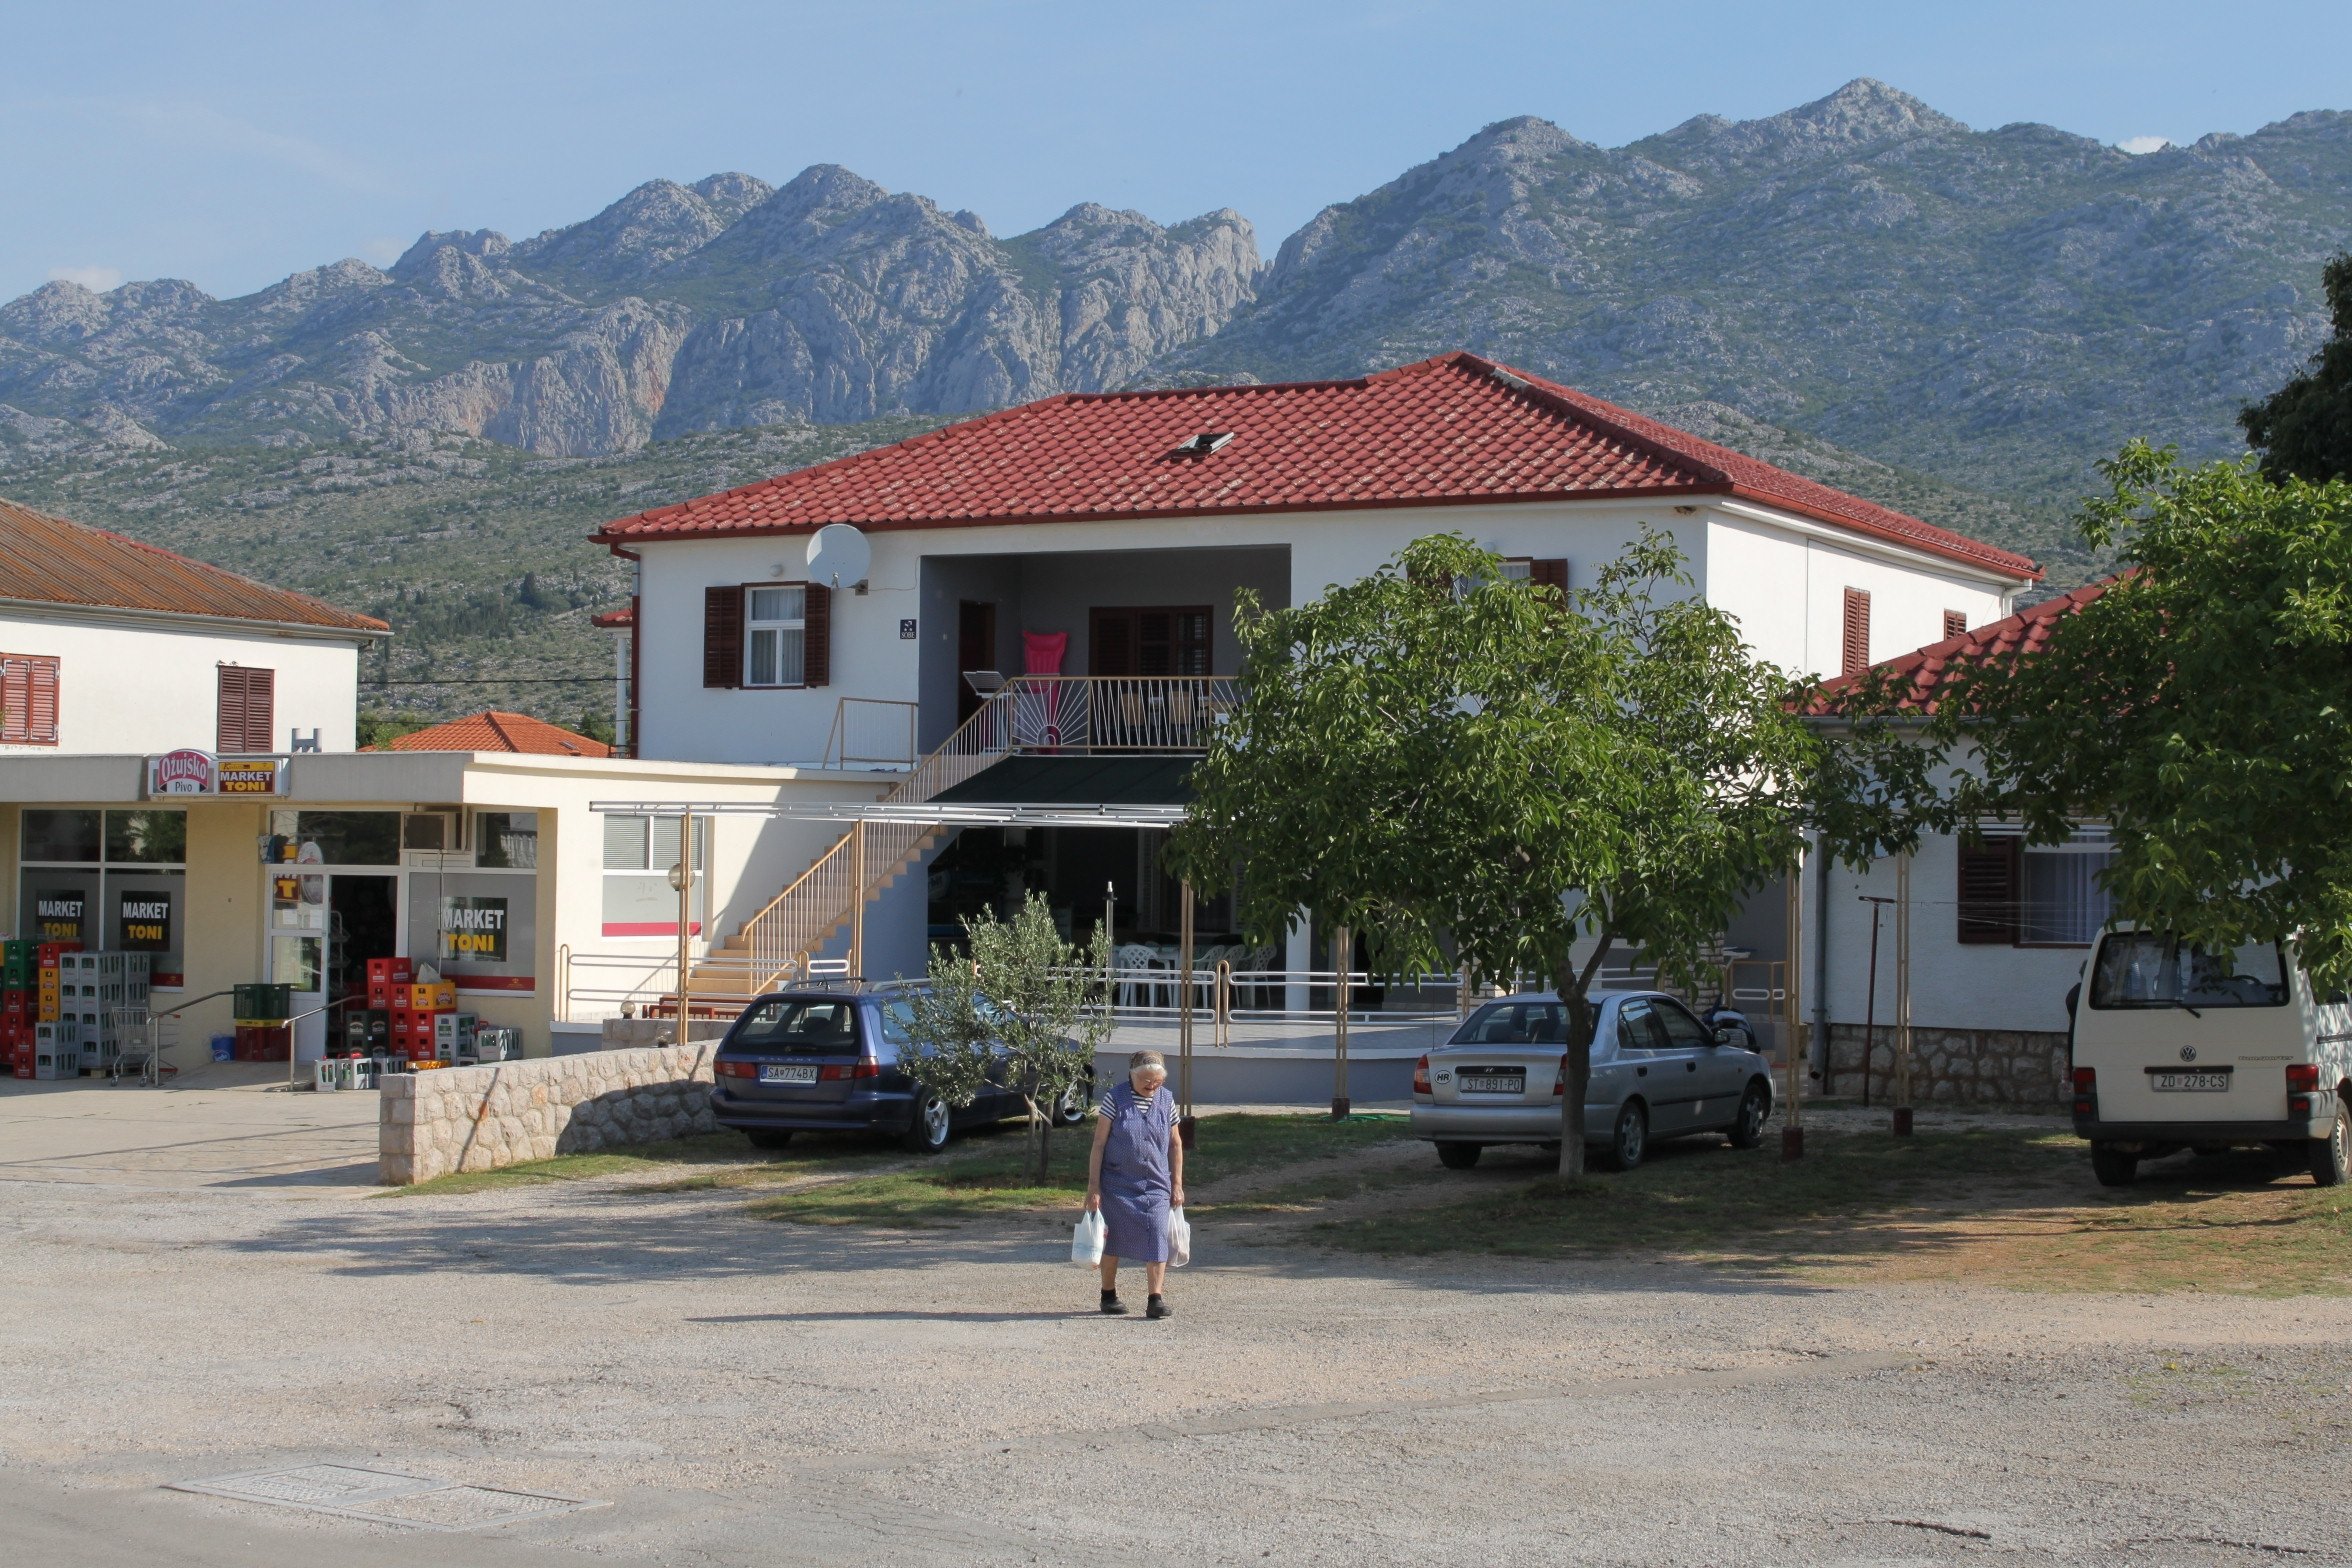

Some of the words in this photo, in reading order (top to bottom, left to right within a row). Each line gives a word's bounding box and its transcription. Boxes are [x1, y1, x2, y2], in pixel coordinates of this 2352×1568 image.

[161, 753, 207, 781] Ožujsko
[220, 771, 272, 781] MARKET
[175, 782, 192, 792] Pivo
[225, 782, 265, 791] TONI
[38, 901, 82, 917] MARKET
[122, 902, 168, 919] MARKET
[442, 909, 504, 929] MARKET
[43, 923, 77, 937] TONI
[128, 925, 162, 939] TONI
[448, 934, 494, 951] TONI
